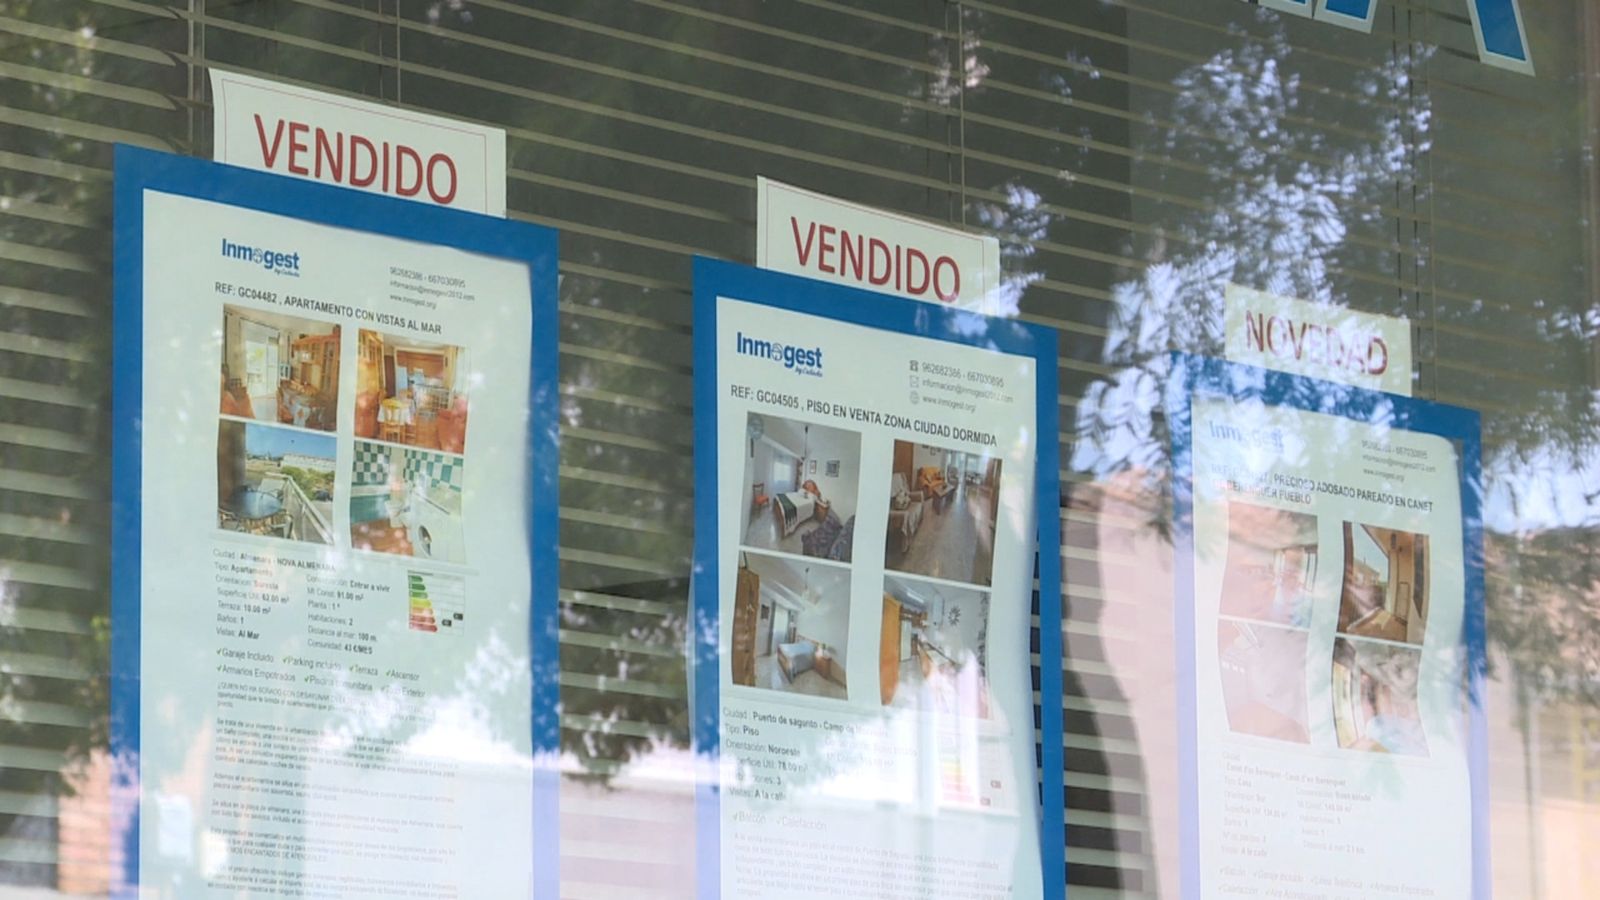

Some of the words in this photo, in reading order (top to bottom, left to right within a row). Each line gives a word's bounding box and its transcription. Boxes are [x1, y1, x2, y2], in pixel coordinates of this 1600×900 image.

[254, 113, 457, 204] VENDIDO
[791, 216, 960, 303] VENDIDO
[215, 281, 236, 297] REF:
[238, 286, 277, 303] GC04482
[284, 295, 353, 317] APARTAMENTO
[355, 307, 375, 321] CON
[376, 312, 405, 328] VISTAS
[407, 318, 419, 331] AL
[420, 321, 442, 335] MAR
[1246, 310, 1388, 375] NOVEDAD
[731, 384, 754, 400] REF:
[757, 390, 799, 409] GC04505
[807, 399, 830, 415] PISO
[833, 404, 847, 418] EN
[849, 407, 882, 425] VENTA
[884, 413, 912, 431] ZONA
[914, 419, 951, 438] CIUDAD
[953, 427, 998, 447] DORMIDA
[1209, 420, 1284, 450] Inmgest
[1274, 473, 1315, 491] PRECIOSO
[1316, 481, 1355, 498] ADOSADO
[1357, 488, 1393, 505] PAREADO
[1395, 496, 1406, 507] EN
[1407, 498, 1433, 513] CANET
[1279, 488, 1312, 504] PUEBLO
[277, 558, 296, 567] NOVA
[350, 579, 370, 590] Entrar
[376, 583, 391, 593] vivir
[238, 630, 246, 638] Al
[247, 631, 260, 640] Mar
[358, 632, 369, 641] 100
[222, 647, 246, 661] Garaje
[247, 651, 275, 663] Incluido
[288, 656, 315, 669] Parking
[354, 664, 378, 676] Terraza
[390, 669, 420, 681] Ascensor
[222, 664, 253, 677] Armarios
[254, 668, 296, 682] Empotrados
[402, 686, 425, 698] Exterior
[743, 725, 759, 737] Piso
[753, 711, 777, 724] Puerto
[778, 715, 787, 725] de
[789, 718, 818, 729] sagunto
